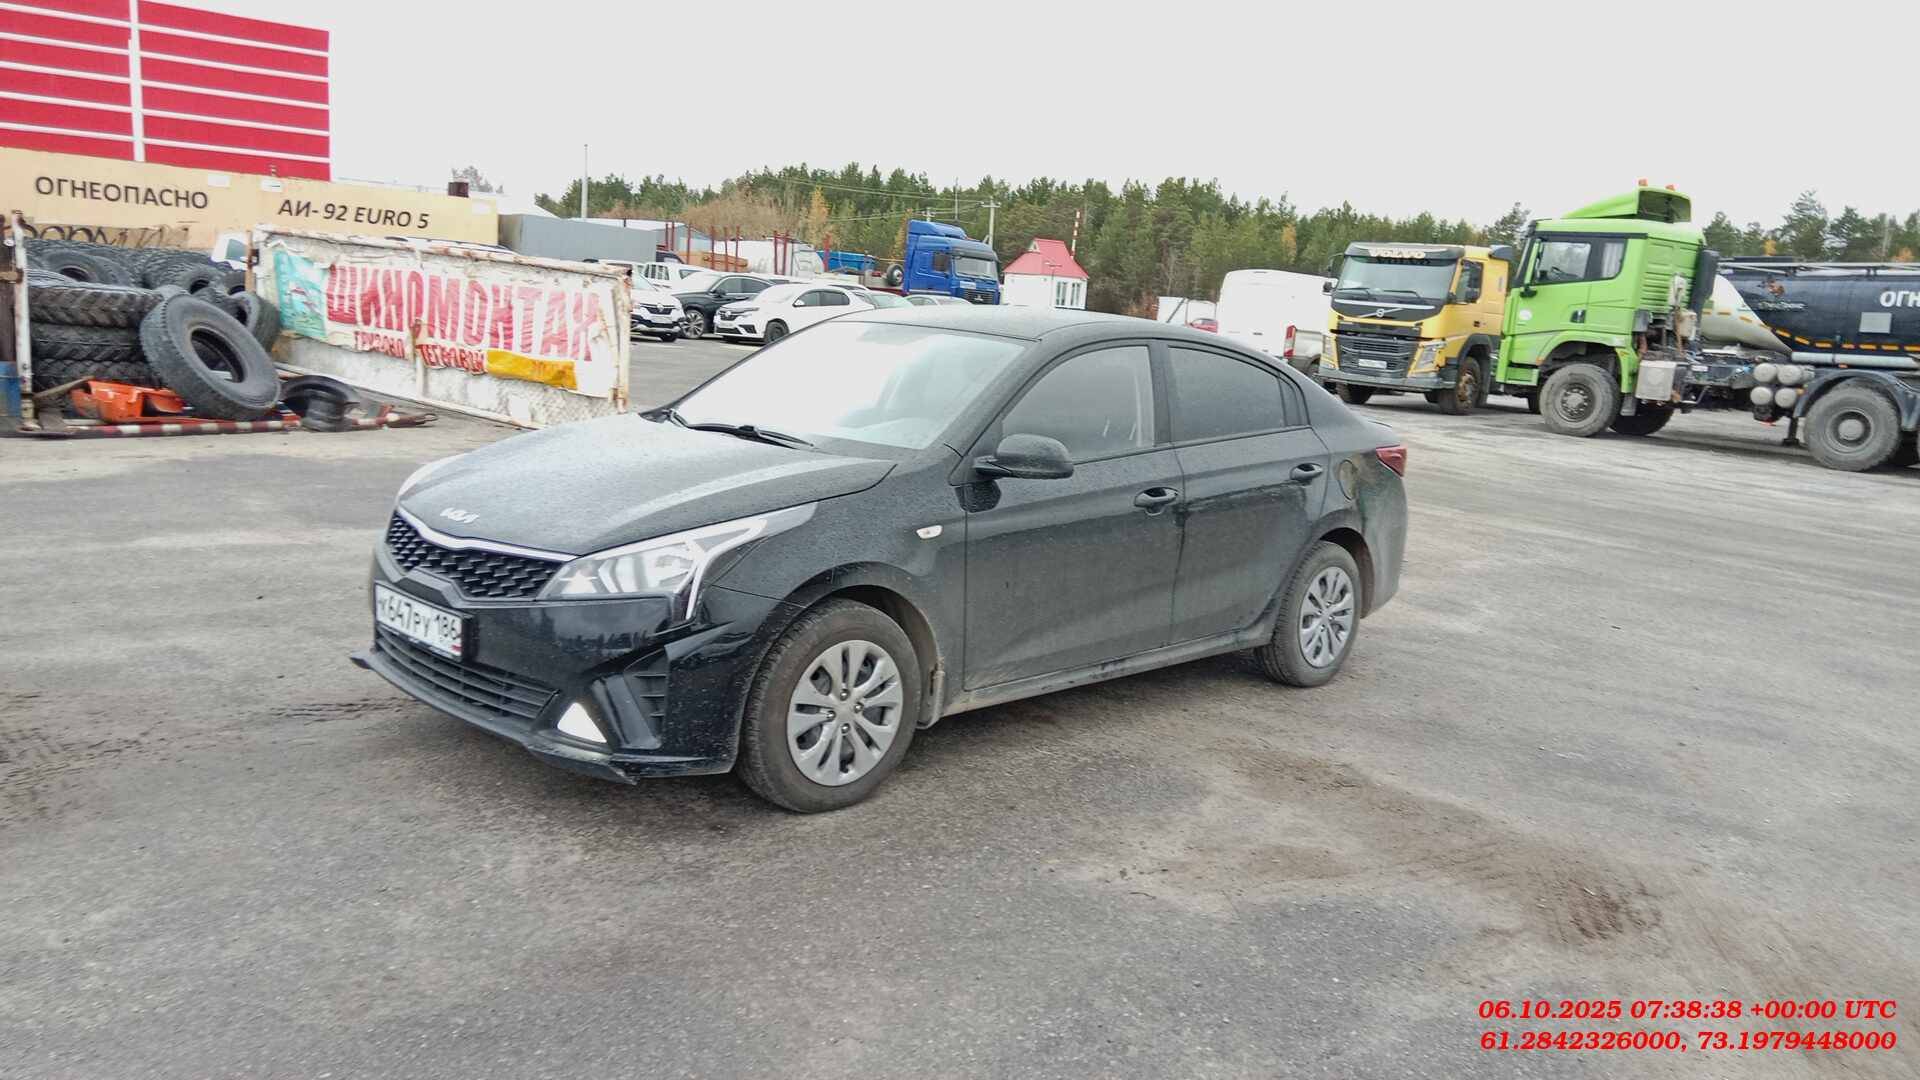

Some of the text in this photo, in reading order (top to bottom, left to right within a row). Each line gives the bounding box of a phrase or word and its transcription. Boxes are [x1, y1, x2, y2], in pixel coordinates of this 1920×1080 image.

[35, 176, 209, 209] ОГНЕОПАСНО
[354, 206, 412, 227] EURO
[416, 213, 430, 229] 5
[1368, 248, 1426, 259] VOLVO
